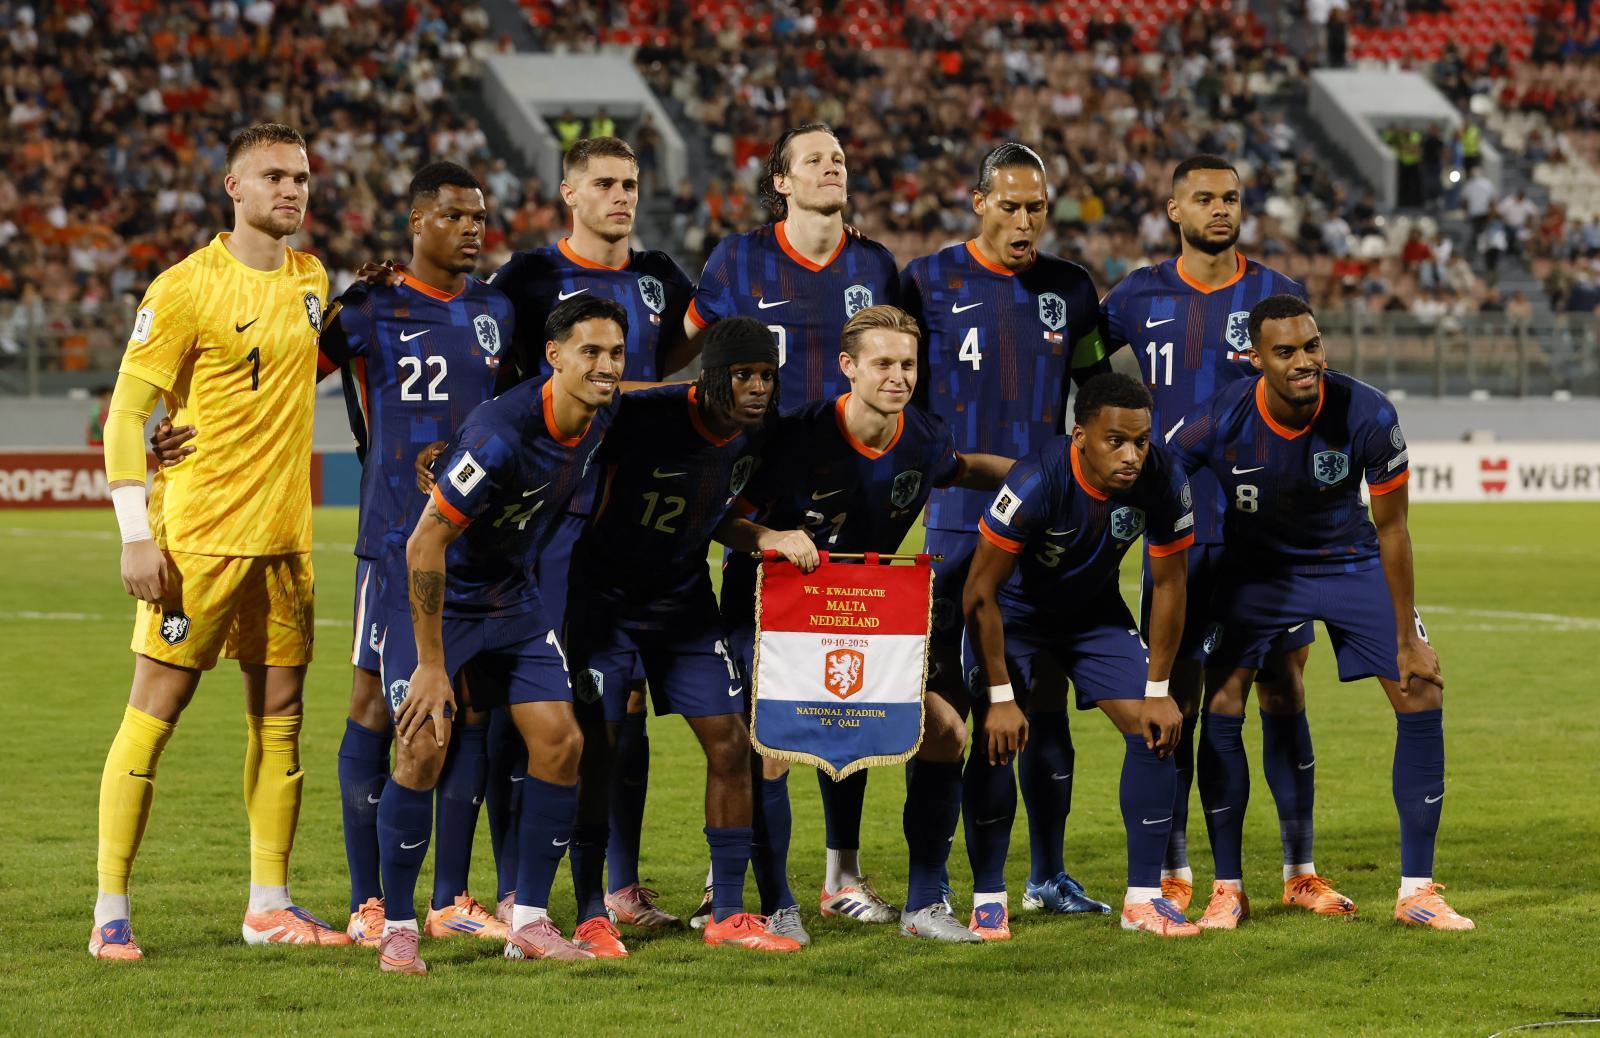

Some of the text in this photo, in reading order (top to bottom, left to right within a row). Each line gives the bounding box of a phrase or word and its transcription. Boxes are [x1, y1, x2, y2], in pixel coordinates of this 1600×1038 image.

[958, 327, 983, 371] 4
[246, 346, 260, 391] 1
[1145, 341, 1174, 386] 11
[397, 355, 449, 401] 22
[1235, 484, 1259, 514] 8
[639, 491, 687, 535] 12
[1034, 541, 1067, 568] 3
[804, 585, 819, 595] WK
[826, 587, 886, 597] KWALIFICATIE
[826, 600, 867, 612] MALTA
[809, 615, 880, 628] NEDERLAND
[821, 638, 869, 647] 09-10-2025
[796, 707, 886, 718] NATIONAL STADIUM
[838, 719, 860, 727] QALI
